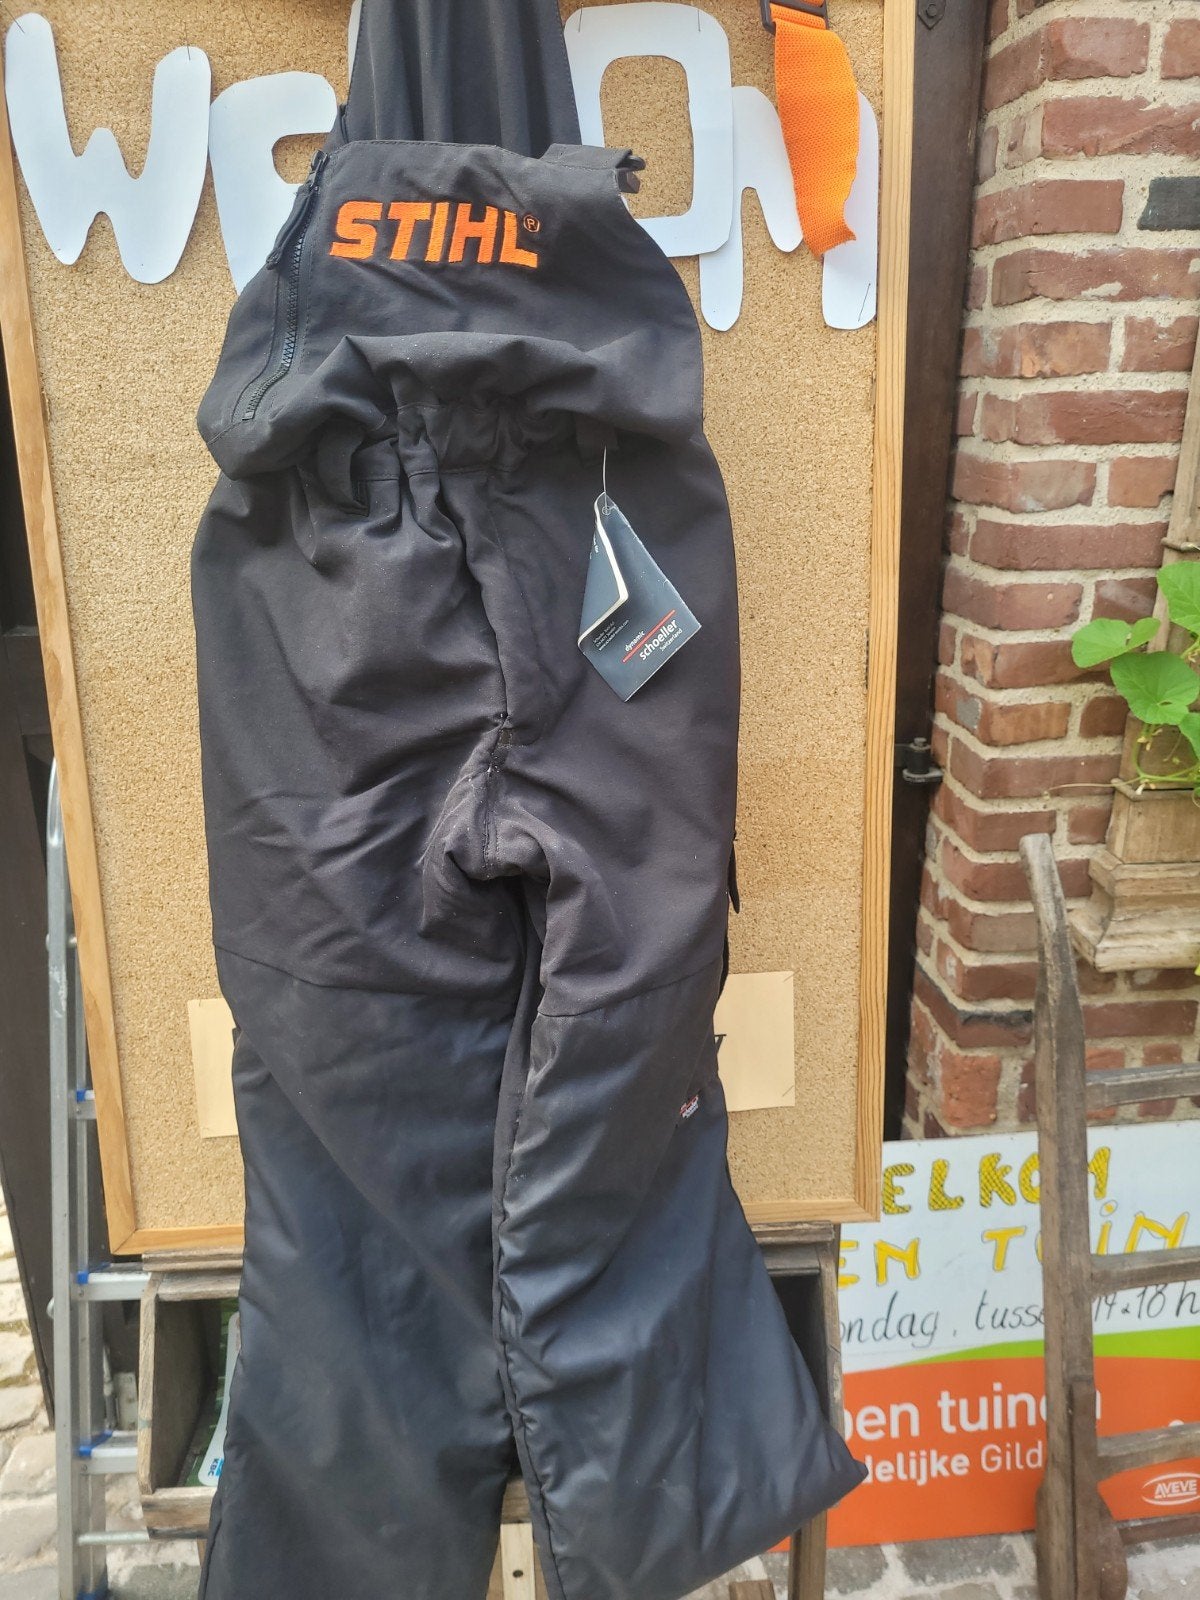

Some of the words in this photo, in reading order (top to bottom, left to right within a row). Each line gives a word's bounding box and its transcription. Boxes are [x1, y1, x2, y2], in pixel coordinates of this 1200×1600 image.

[624, 630, 645, 652] dynamic
[639, 619, 678, 661] schoeller
[659, 627, 683, 652] Switzerland
[837, 1237, 921, 1288] EN
[1154, 1479, 1198, 1500] AVEVE
